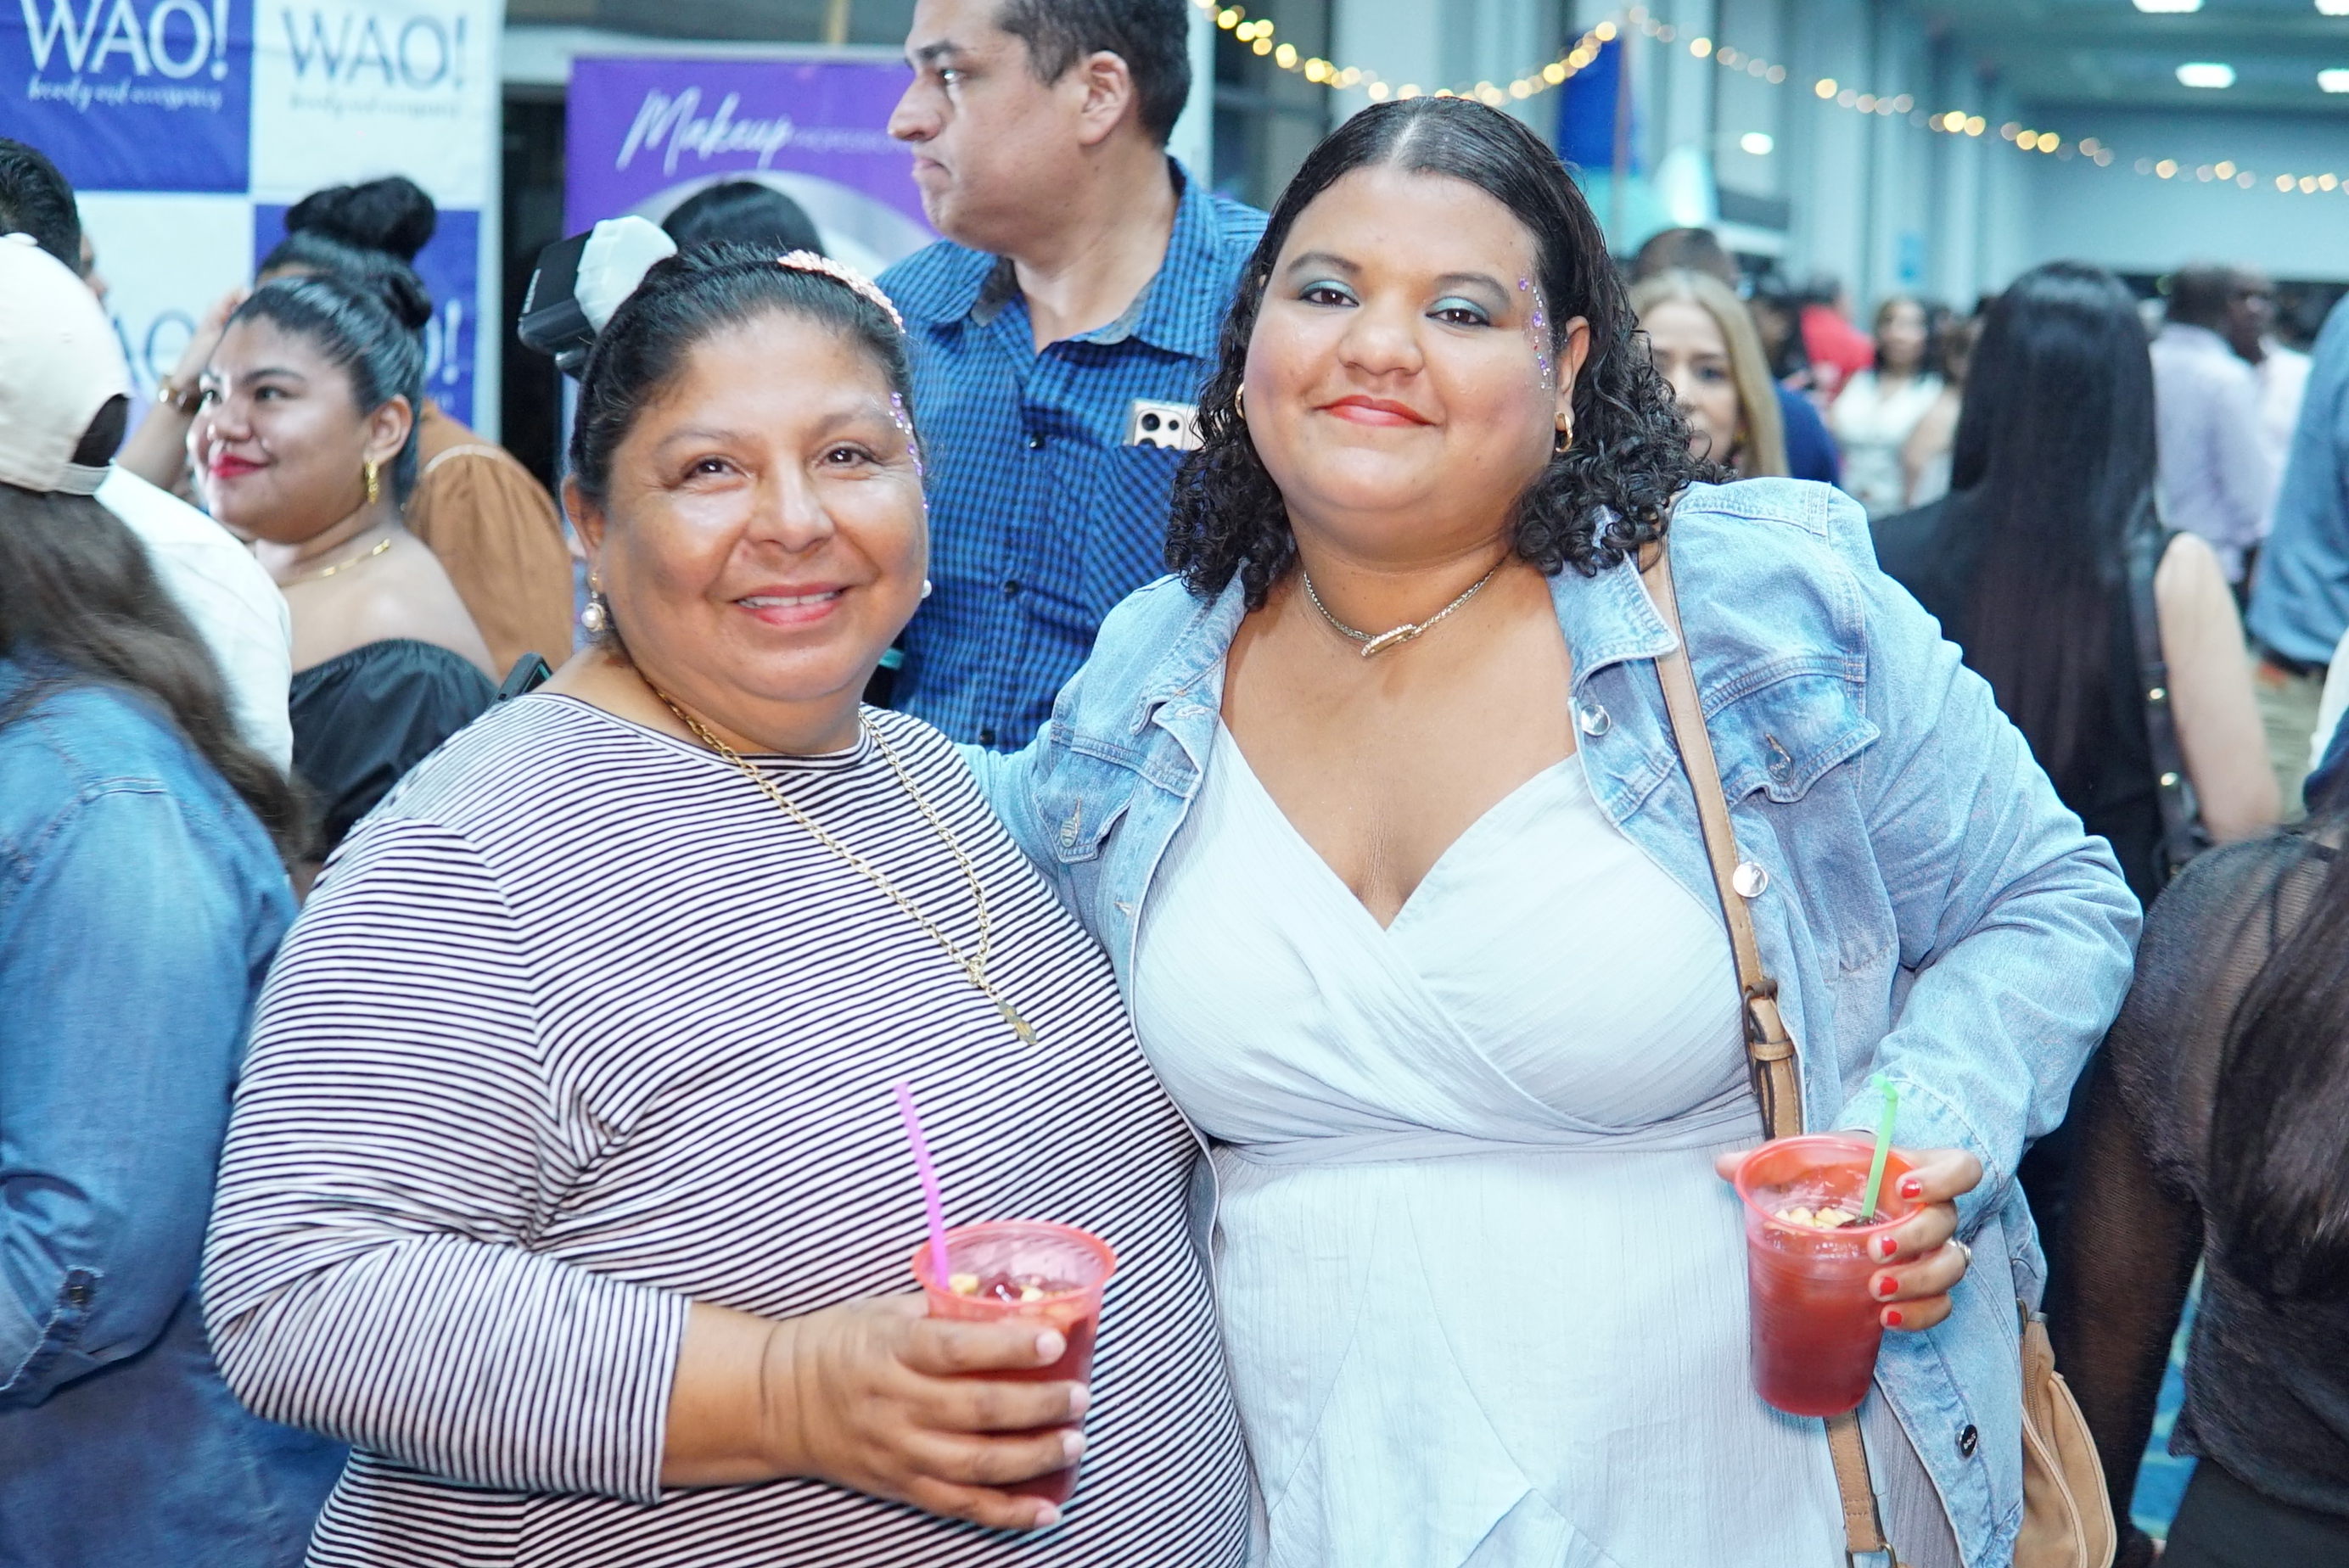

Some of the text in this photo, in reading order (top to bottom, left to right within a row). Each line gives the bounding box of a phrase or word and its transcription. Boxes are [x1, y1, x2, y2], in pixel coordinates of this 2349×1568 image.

[20, 0, 230, 81] WAO!
[281, 8, 468, 92] WAO!
[616, 86, 795, 176] Makeup
